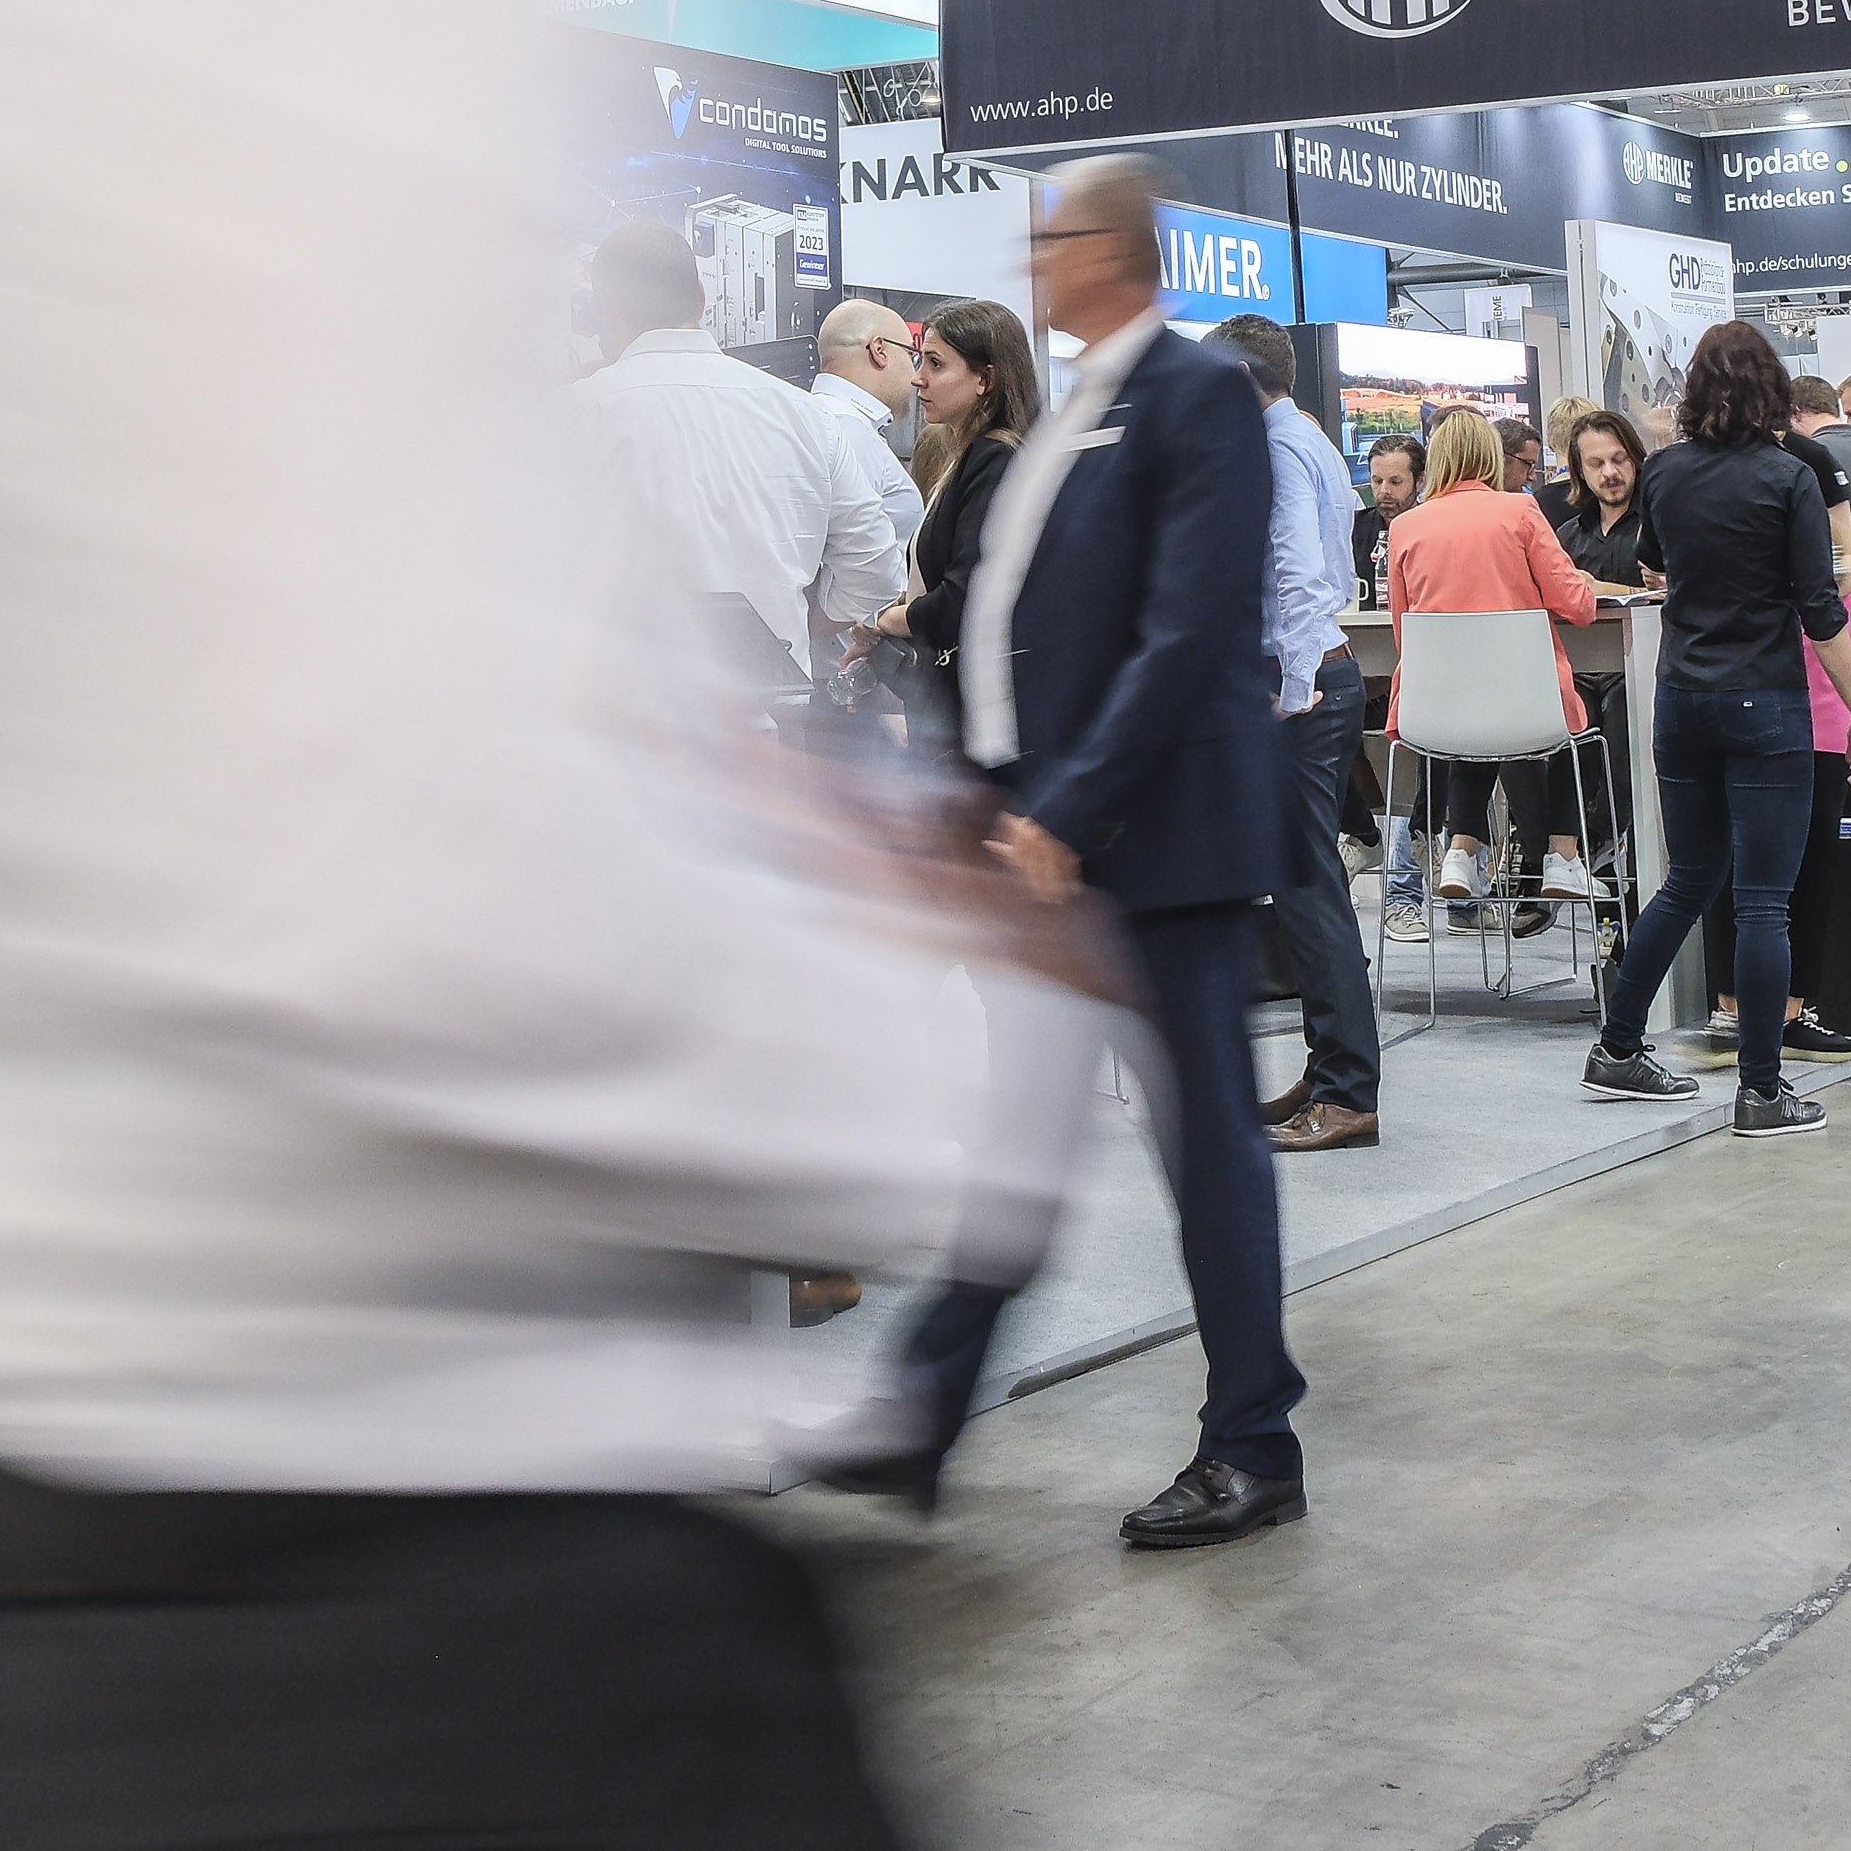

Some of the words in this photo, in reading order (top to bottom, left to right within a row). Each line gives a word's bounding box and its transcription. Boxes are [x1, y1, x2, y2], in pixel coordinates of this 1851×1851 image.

[970, 87, 1114, 122] www.ahp.de
[745, 137, 771, 150] DIGITAL
[772, 141, 790, 153] TOOL
[791, 145, 827, 159] SOLUTIONS
[1623, 141, 1645, 185] AHP
[1338, 147, 1374, 190] ALS
[1378, 155, 1418, 199] NUR
[1421, 166, 1508, 215] ZYLINDER.
[1724, 188, 1836, 213] Entdecken
[799, 235, 824, 251] 2023
[1669, 253, 1701, 290] GHD
